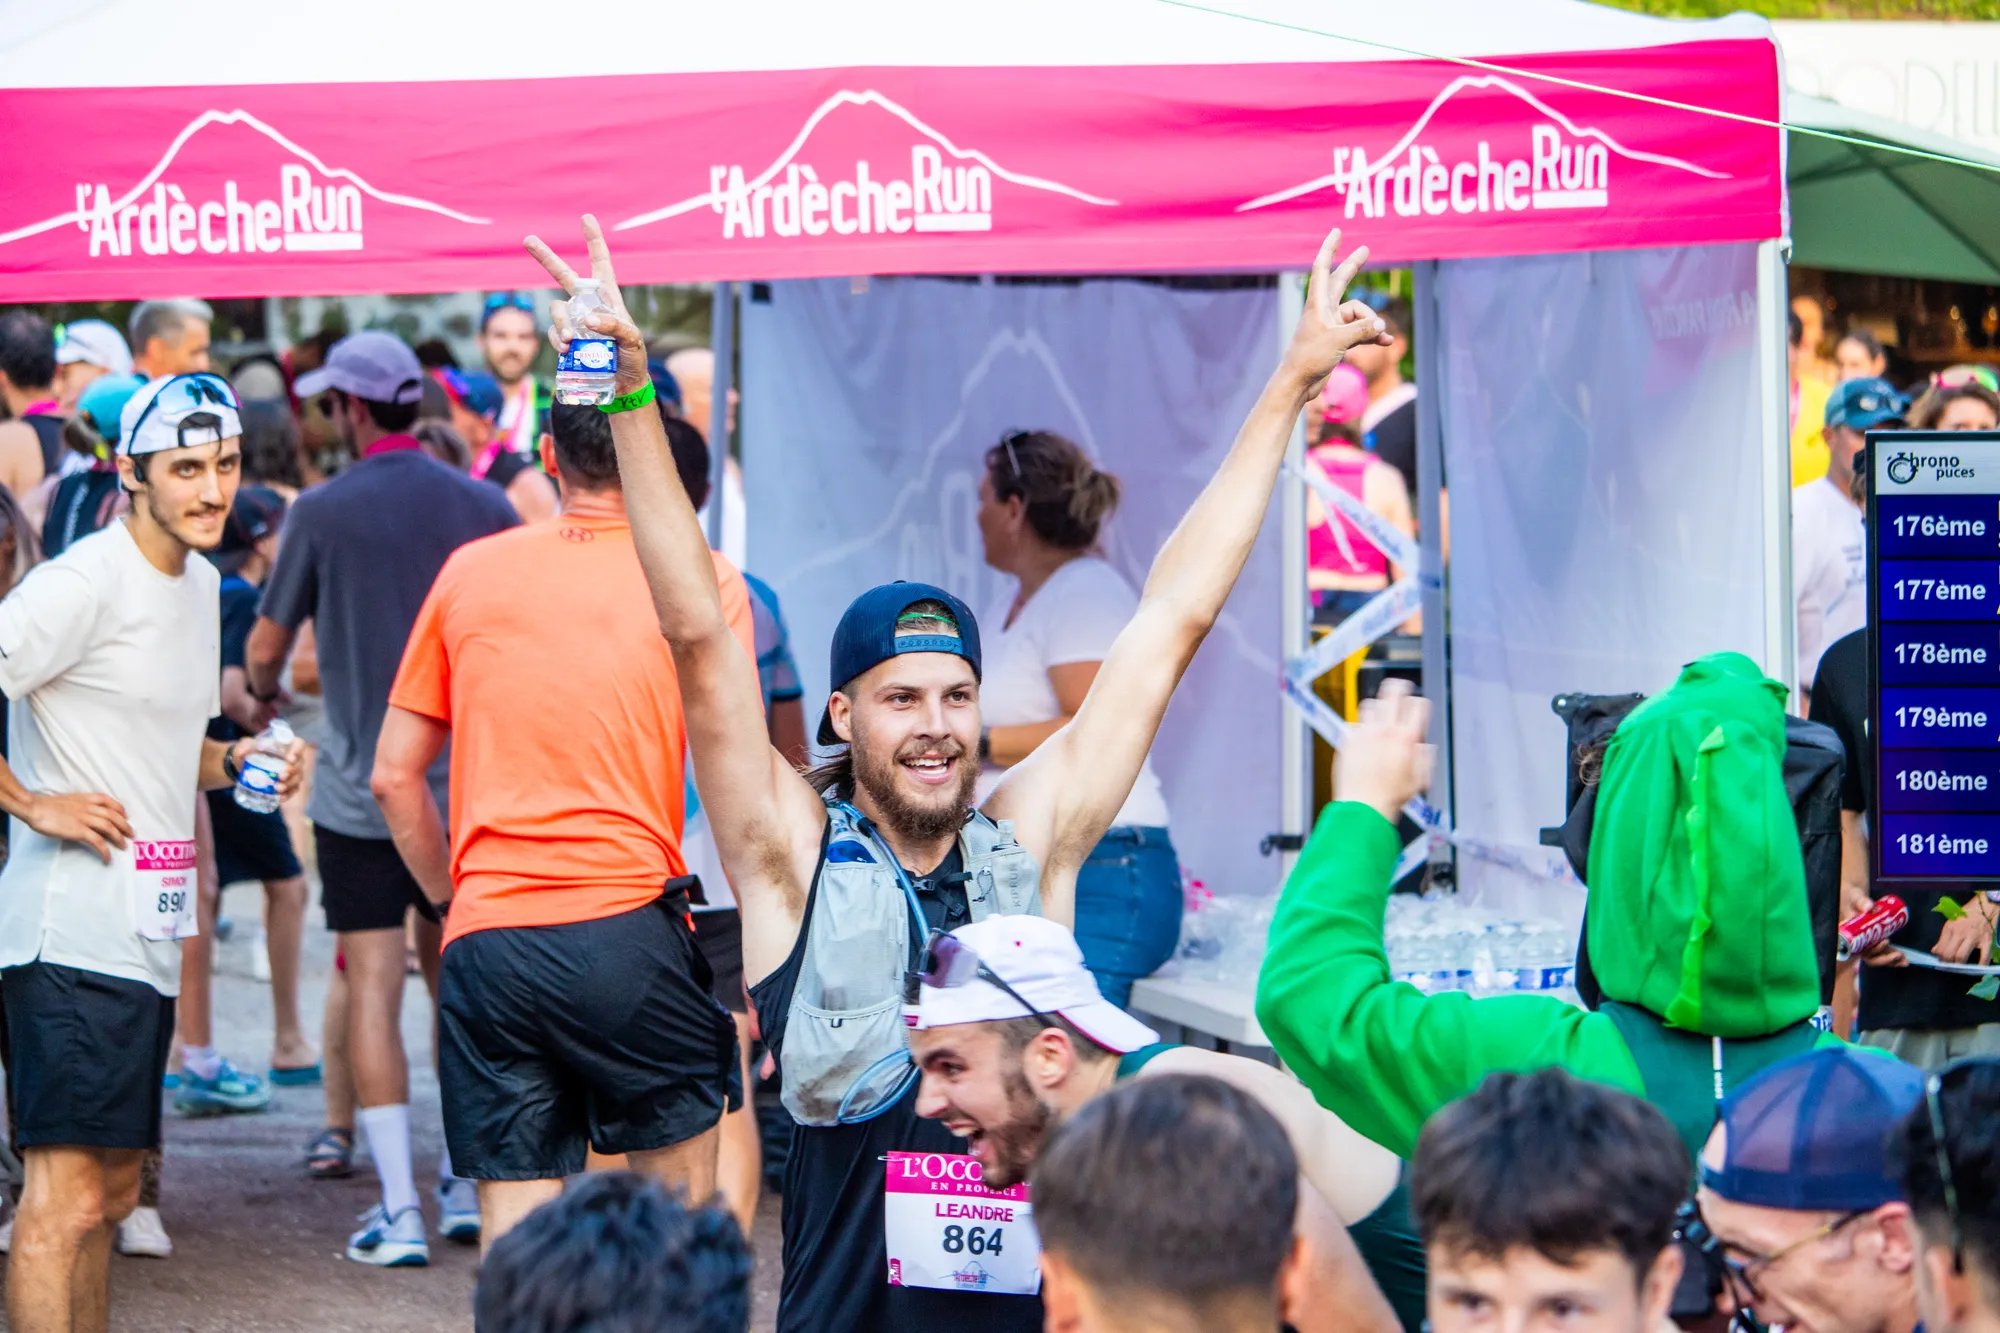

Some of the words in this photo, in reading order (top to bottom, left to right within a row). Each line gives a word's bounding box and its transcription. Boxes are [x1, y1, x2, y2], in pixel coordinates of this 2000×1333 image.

[1936, 468, 1975, 482] puces
[1893, 514, 1986, 537] 176ème
[1894, 579, 1987, 601] 177ème
[1894, 642, 1987, 664] 178ème
[1895, 706, 1988, 728] 179ème
[1895, 769, 1988, 791] 180ème
[1896, 833, 1989, 855] 181ème
[157, 891, 186, 913] 890
[901, 1154, 984, 1182] L'OCC
[931, 1182, 949, 1191] EN
[935, 1202, 1014, 1222] LEANDRE
[942, 1224, 1003, 1256] 864
